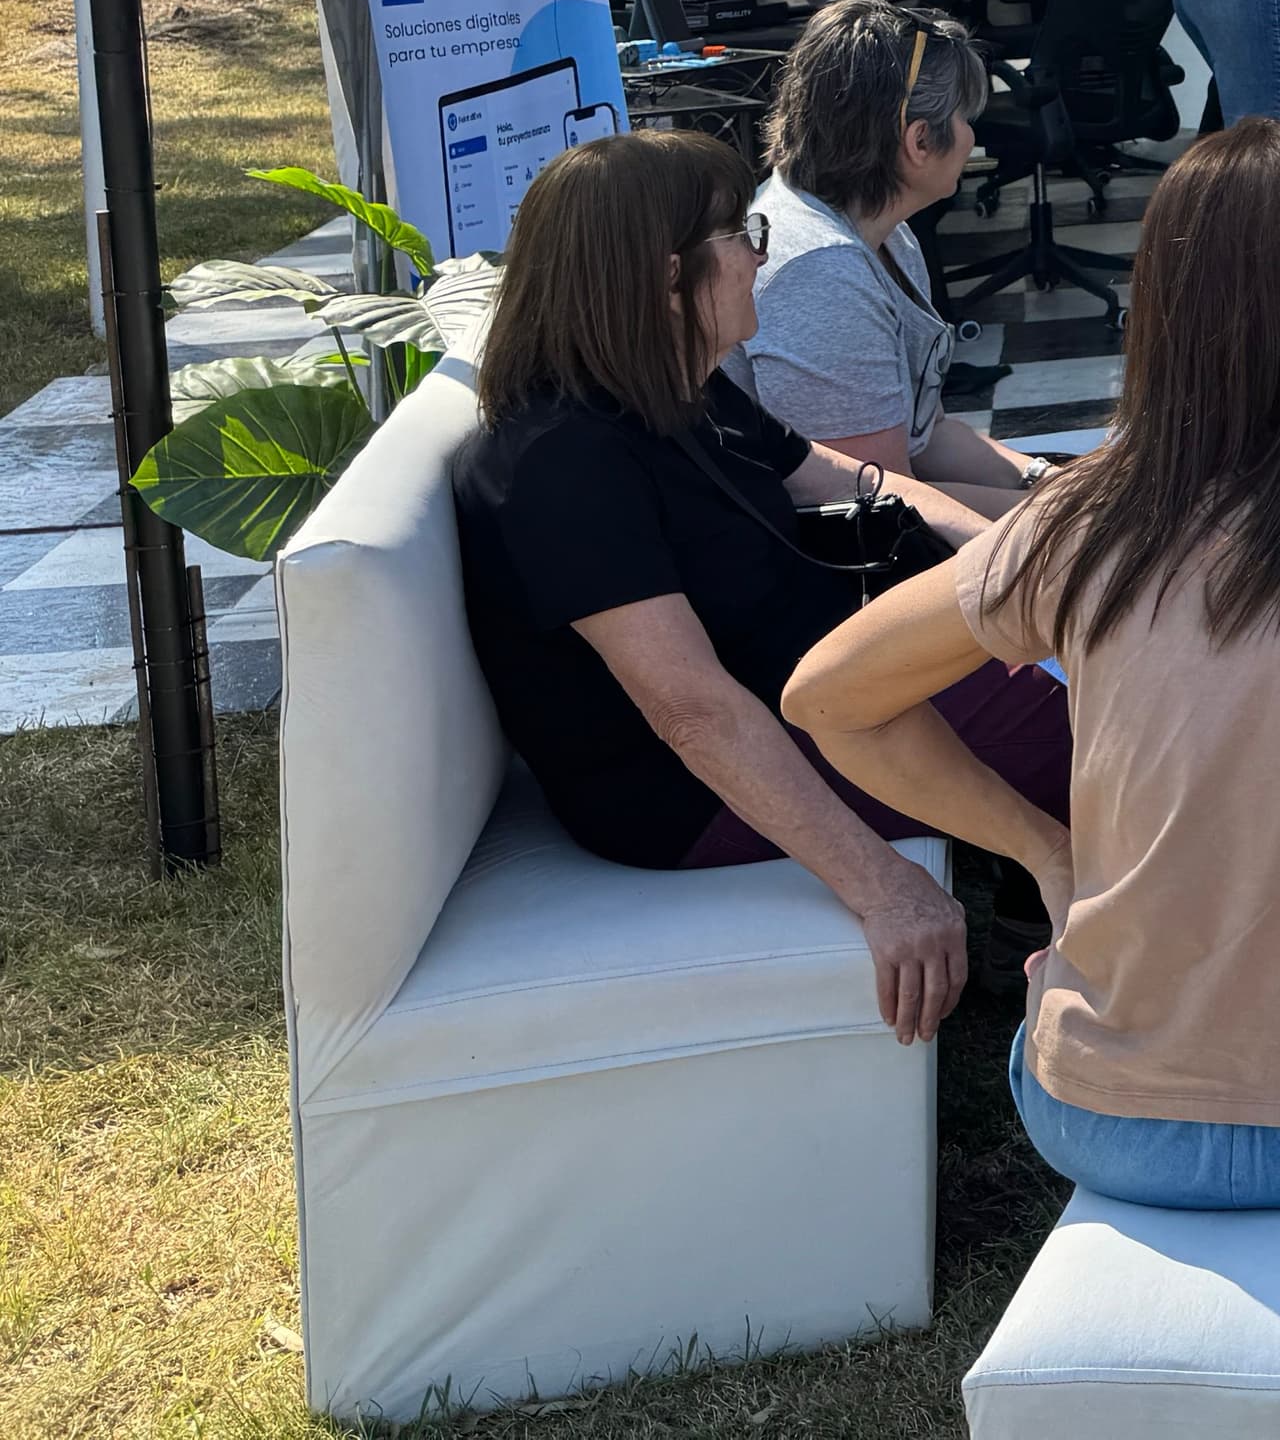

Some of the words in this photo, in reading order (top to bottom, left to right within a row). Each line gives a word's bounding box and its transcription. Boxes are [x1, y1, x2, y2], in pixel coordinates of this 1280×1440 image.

[385, 17, 462, 39] Soluciones
[465, 10, 521, 33] digitales
[388, 48, 426, 68] para
[430, 45, 447, 59] tu
